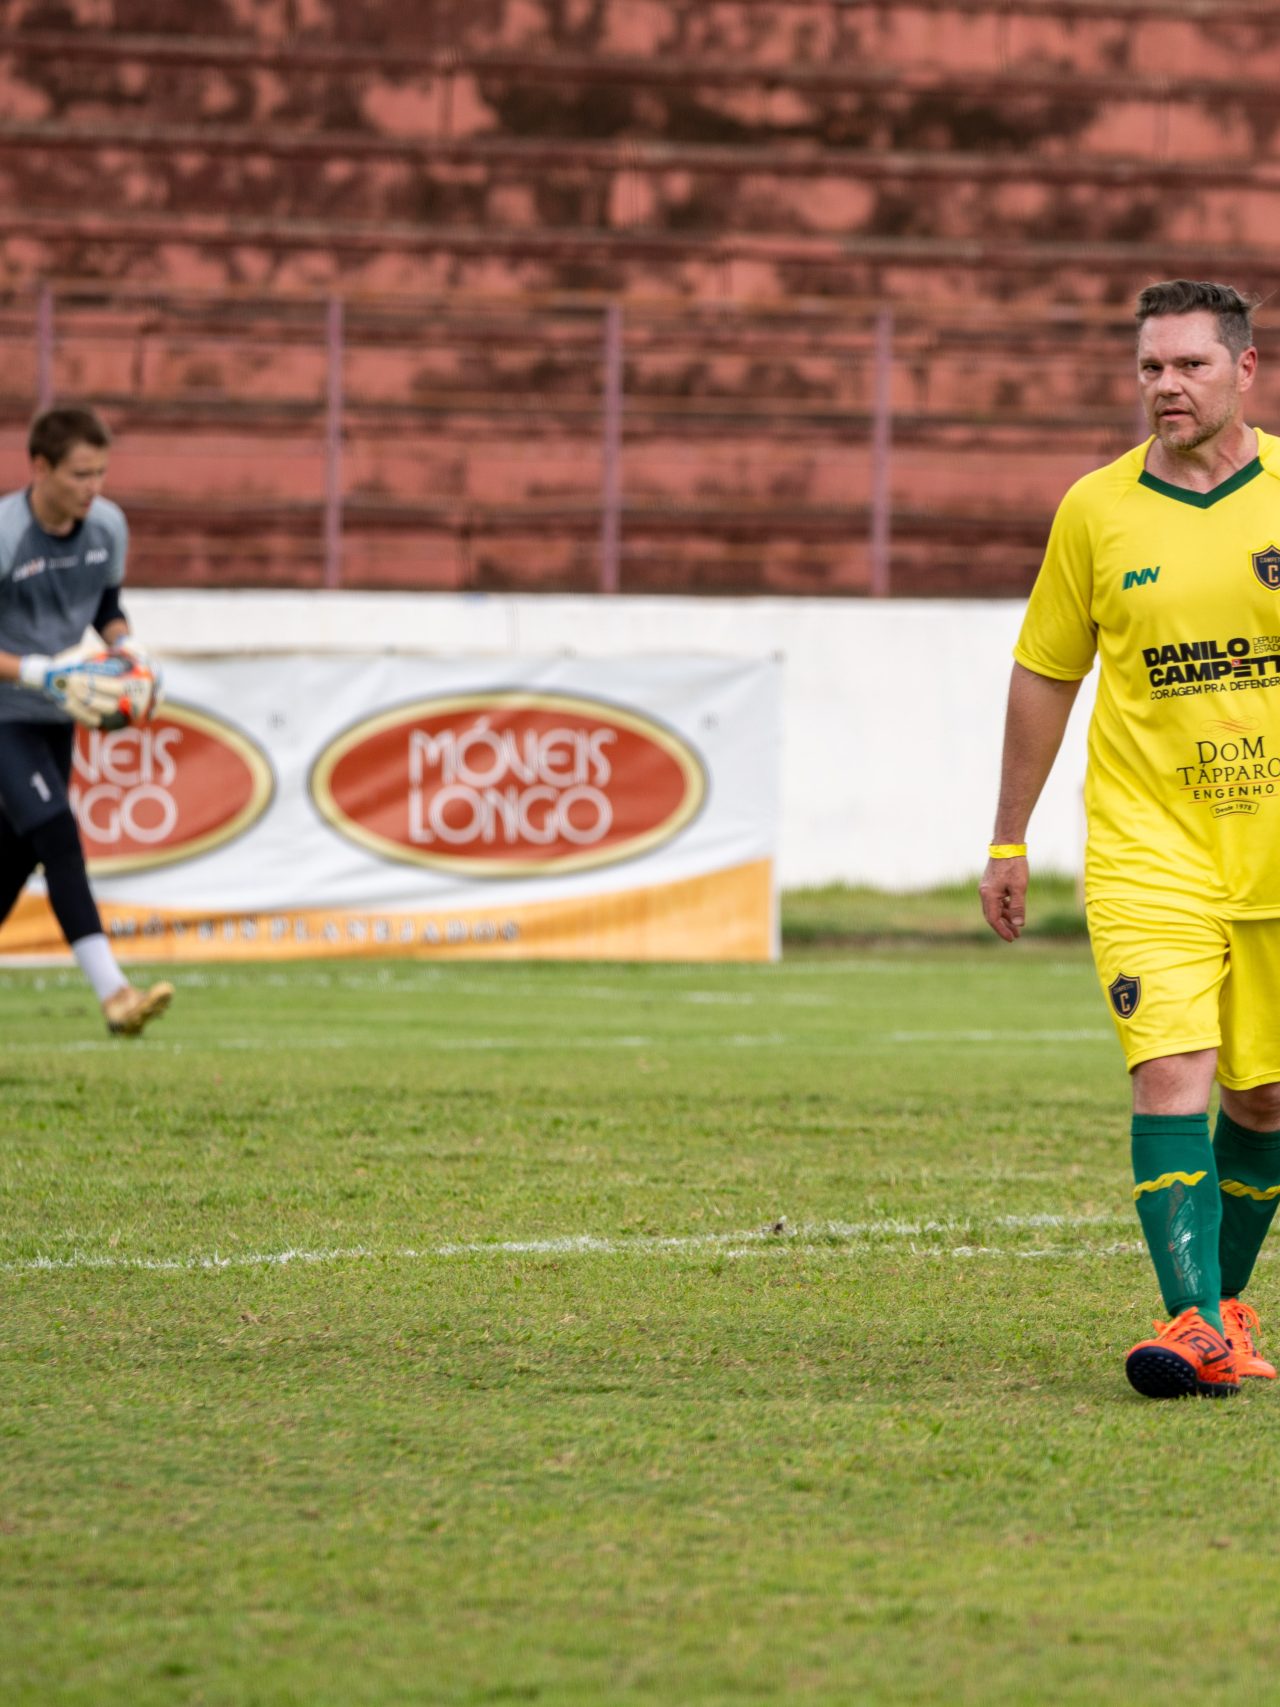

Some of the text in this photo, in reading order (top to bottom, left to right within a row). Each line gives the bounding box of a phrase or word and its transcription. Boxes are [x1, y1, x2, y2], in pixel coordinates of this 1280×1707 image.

[1122, 566, 1160, 590] INN
[1268, 564, 1279, 583] C
[1142, 637, 1250, 668] DANILO
[1151, 684, 1202, 700] CORAGEM
[1204, 683, 1228, 694] PRA
[1230, 676, 1280, 691] DEFENDER
[72, 727, 183, 787] VEIS
[408, 715, 618, 788] MÓVEIS
[1195, 735, 1266, 764] DOM
[31, 771, 50, 802] 1
[1193, 784, 1275, 800] ENGENHO
[408, 783, 614, 844] LONGO
[1215, 805, 1234, 814] Desde
[270, 917, 521, 942] PLANEJADOS
[1120, 992, 1131, 1013] C
